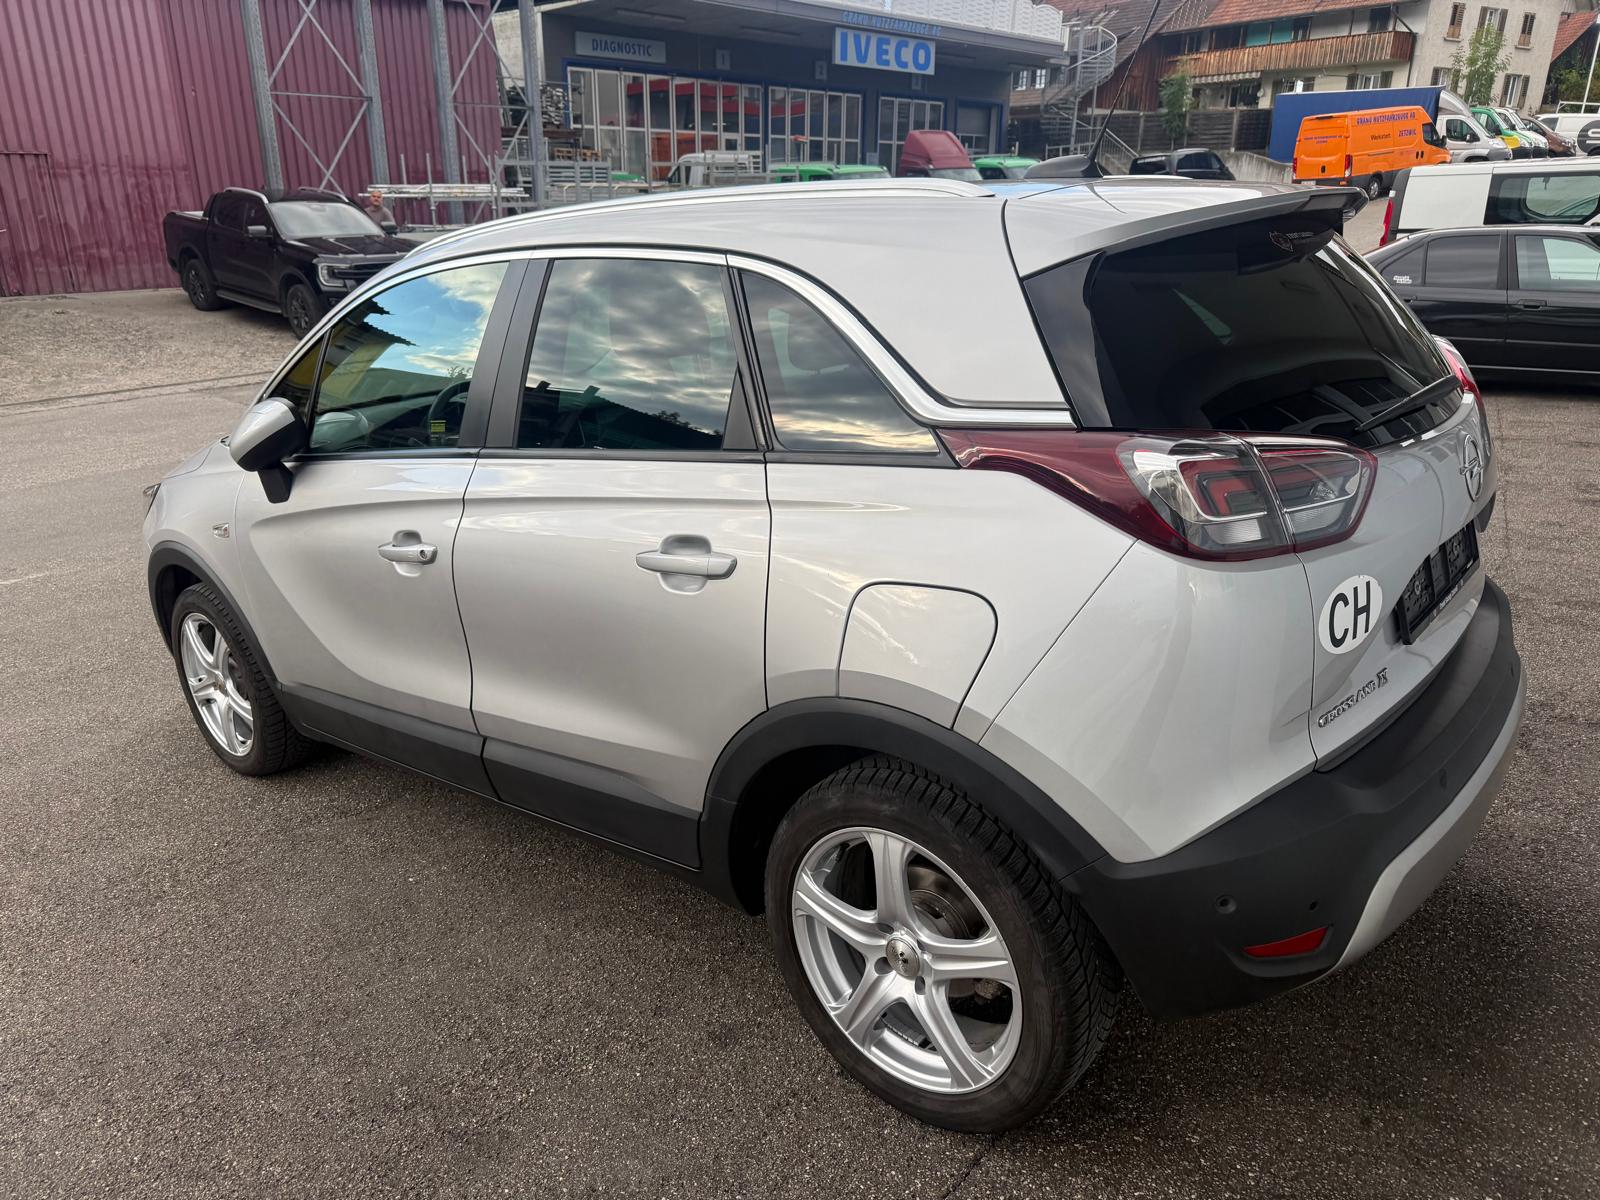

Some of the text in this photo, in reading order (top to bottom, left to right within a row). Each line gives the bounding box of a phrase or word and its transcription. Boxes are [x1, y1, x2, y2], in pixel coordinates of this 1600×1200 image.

[591, 38, 652, 57] DIAGNOSTIC
[840, 31, 931, 71] IVECO
[1328, 580, 1371, 649] CH
[1318, 667, 1388, 728] CROSSLAND X
